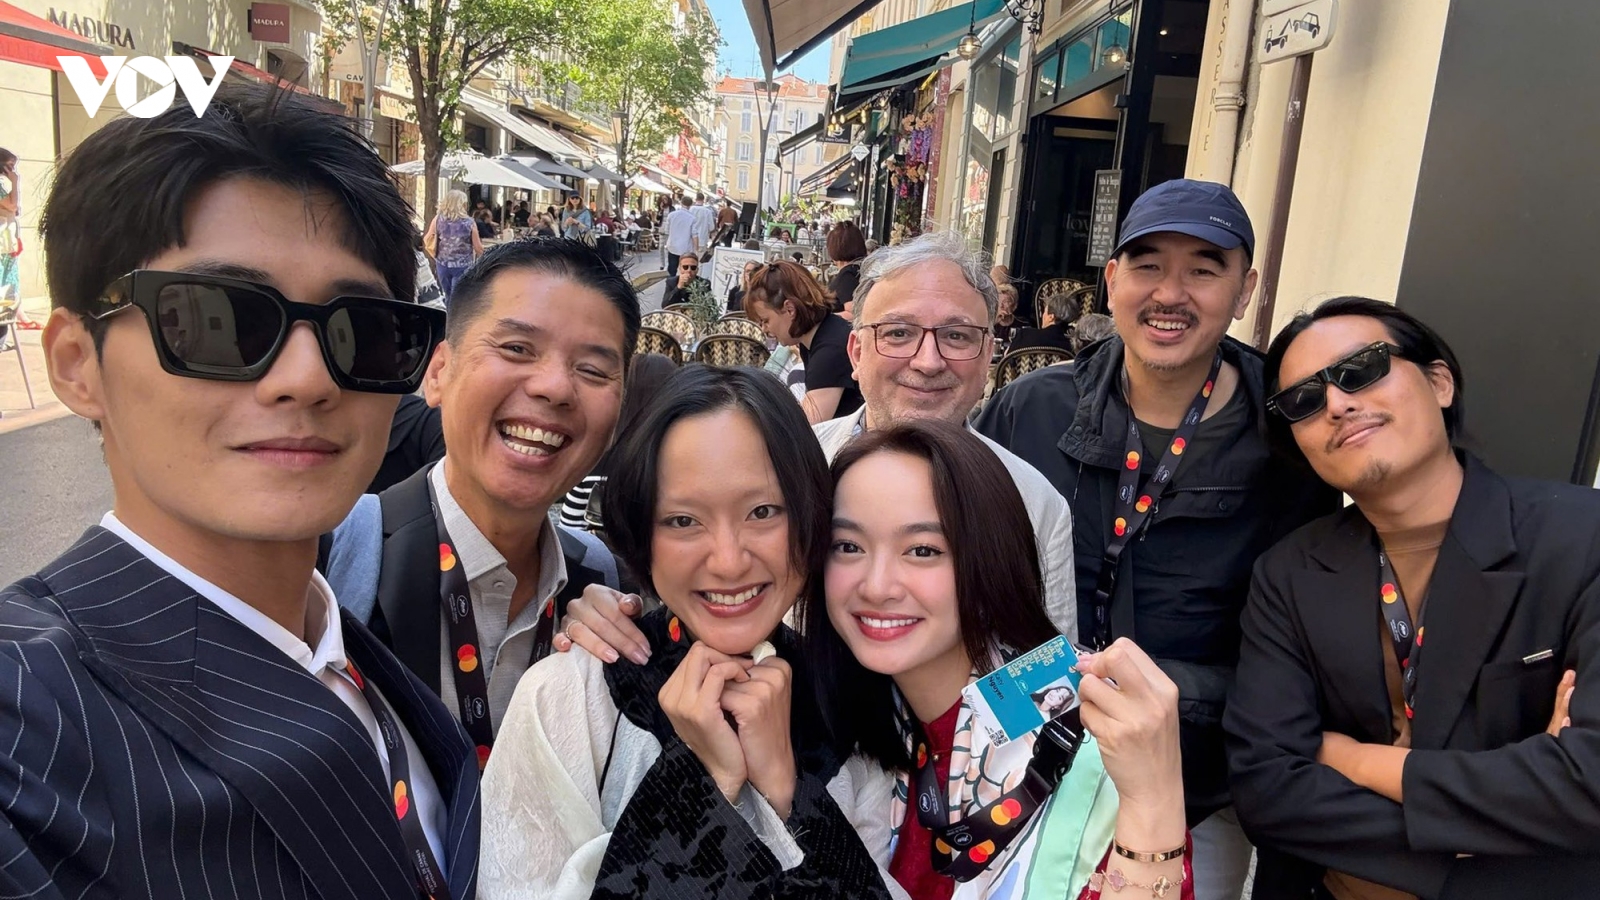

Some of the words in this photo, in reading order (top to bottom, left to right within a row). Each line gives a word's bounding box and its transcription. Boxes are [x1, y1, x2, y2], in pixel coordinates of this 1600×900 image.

[47, 7, 136, 50] MADURA
[253, 18, 285, 27] MADURA
[1209, 215, 1232, 227] FORCLAZ
[1041, 645, 1056, 664] INTER
[1046, 643, 1057, 656] VAL
[1051, 640, 1065, 658] FESTI
[1016, 660, 1025, 670] DE
[1021, 657, 1034, 672] FILM
[1026, 654, 1036, 665] DU
[1031, 651, 1042, 664] NAL
[1036, 648, 1050, 667] NATIO
[1011, 662, 1022, 677] CAN
[987, 675, 1005, 701] Nguyen
